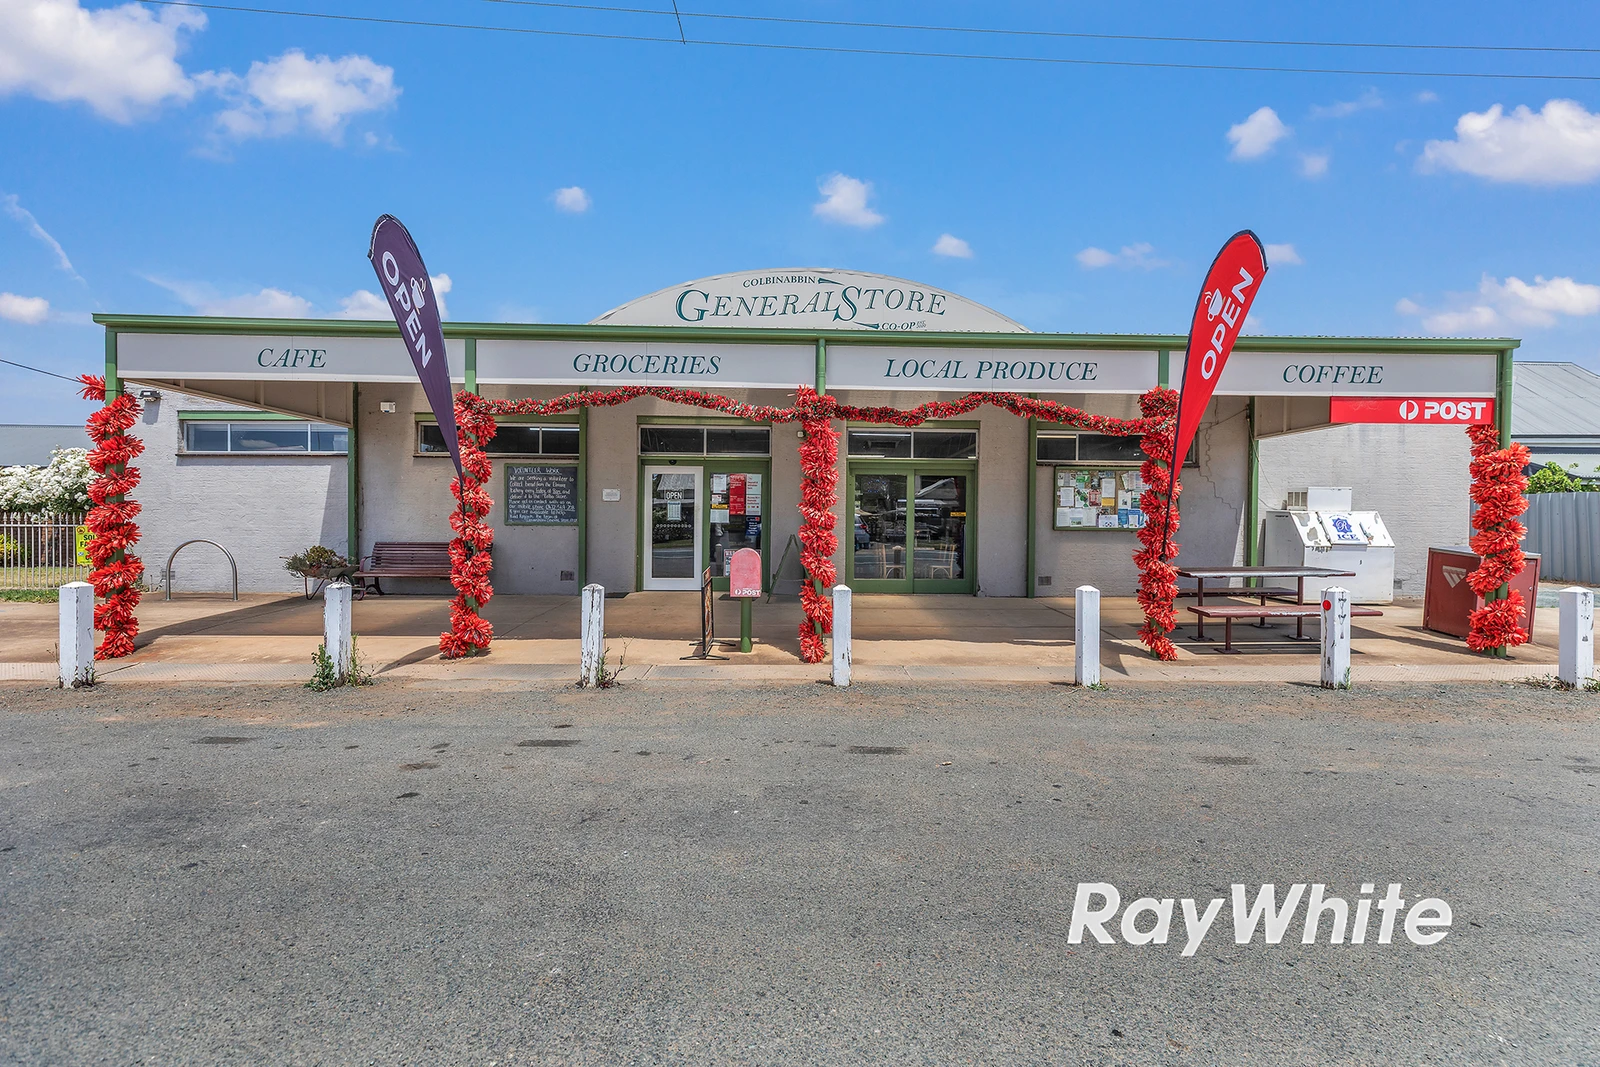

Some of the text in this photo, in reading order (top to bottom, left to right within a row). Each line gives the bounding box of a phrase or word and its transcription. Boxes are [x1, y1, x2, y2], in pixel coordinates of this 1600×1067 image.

[743, 275, 816, 288] COLBINABBIN
[382, 251, 432, 368] OPEN
[1201, 267, 1254, 380] OPEN
[257, 348, 327, 368] CAFE
[572, 353, 721, 375] GROCERIES
[884, 358, 1098, 381] LOCAL PRODUCE
[1283, 364, 1384, 384] COFFEE
[1424, 401, 1486, 420] POST
[666, 491, 683, 500] OPEN
